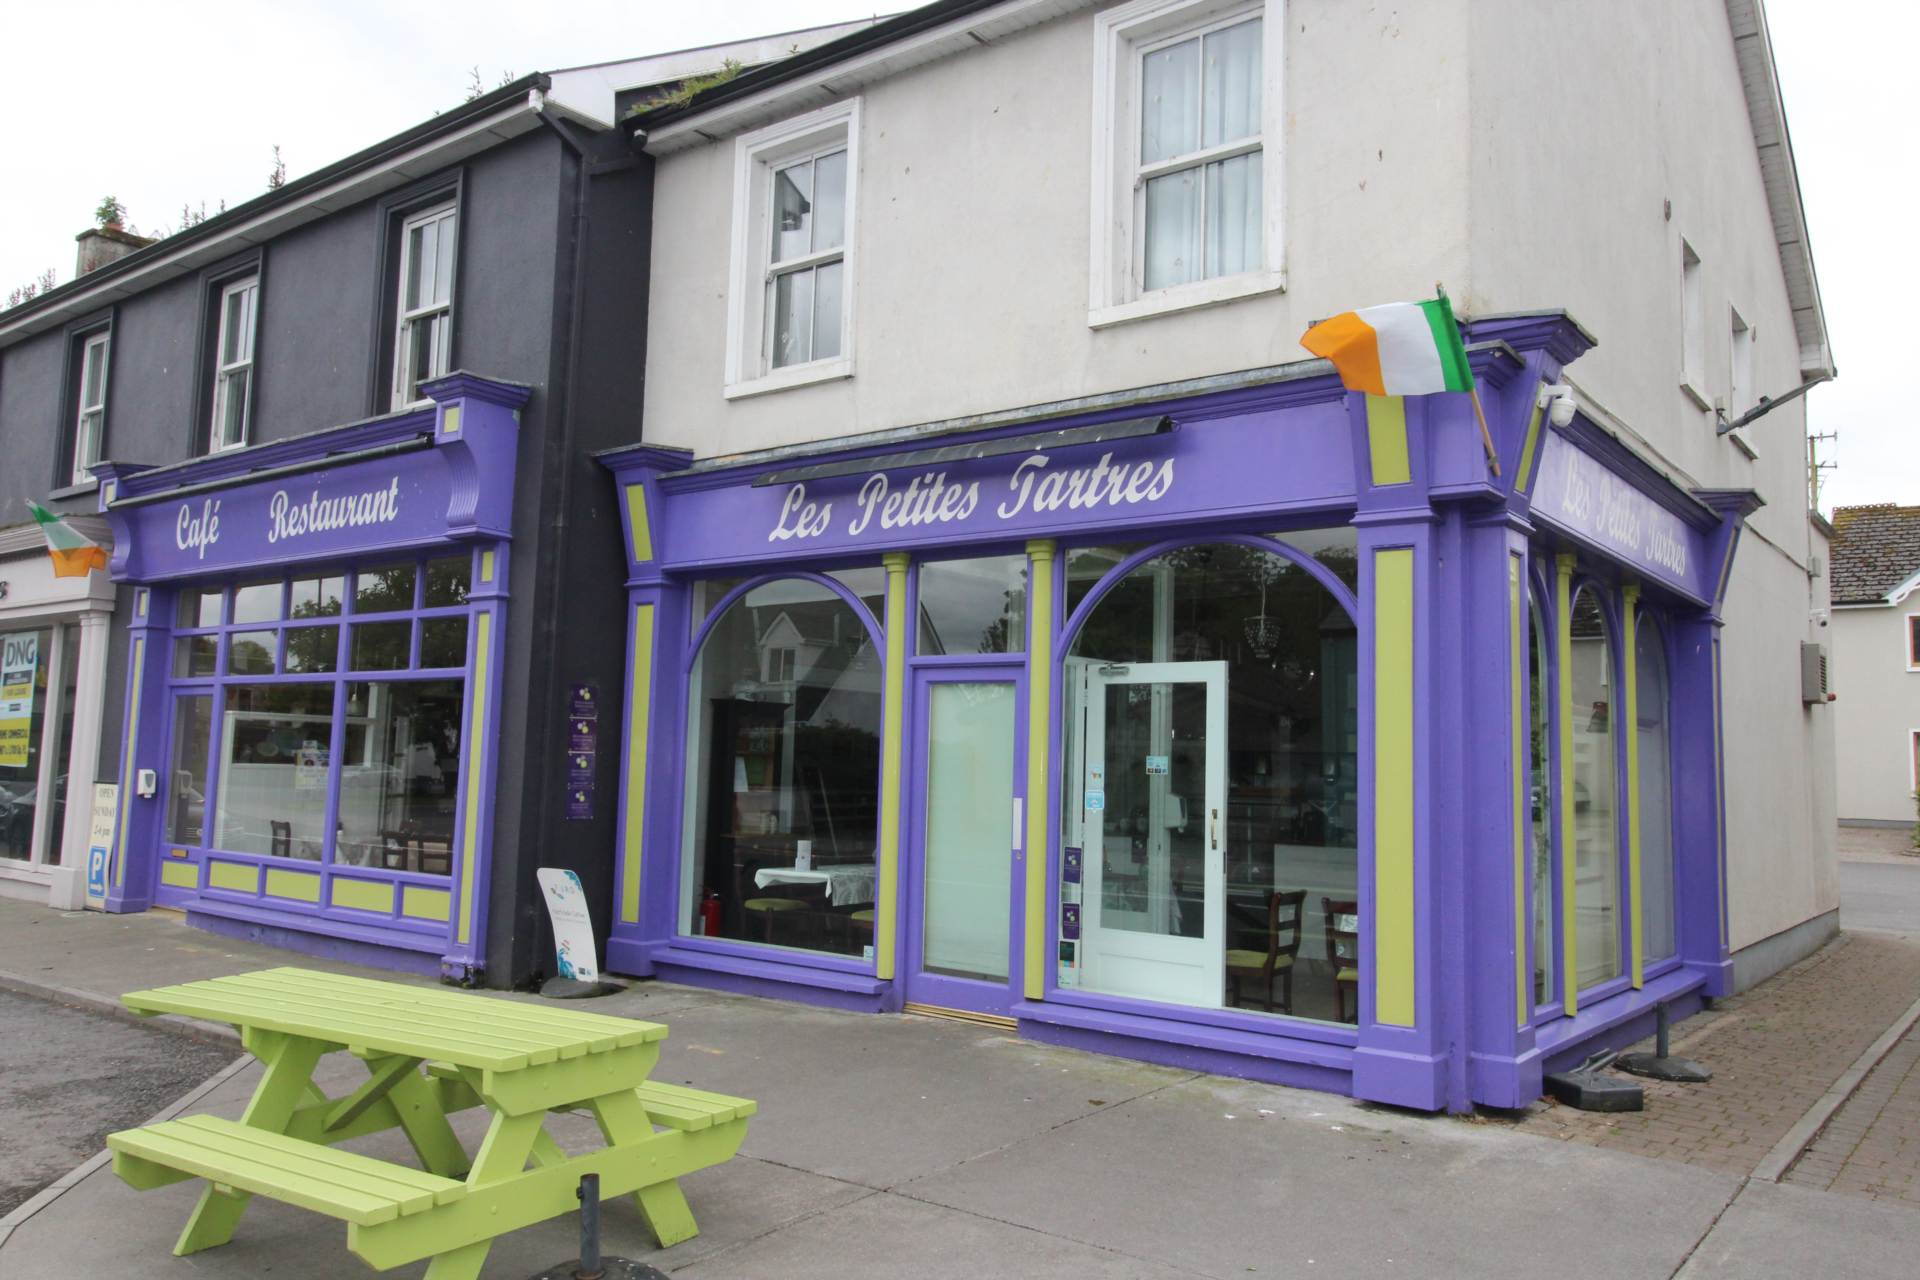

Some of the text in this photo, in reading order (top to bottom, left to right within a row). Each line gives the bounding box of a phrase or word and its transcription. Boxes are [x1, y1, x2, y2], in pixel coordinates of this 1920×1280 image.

[176, 476, 399, 560] Café Restaurant
[768, 451, 1176, 542] Les Petites Tartres
[1561, 453, 1590, 521] Les
[5, 638, 36, 668] DNG
